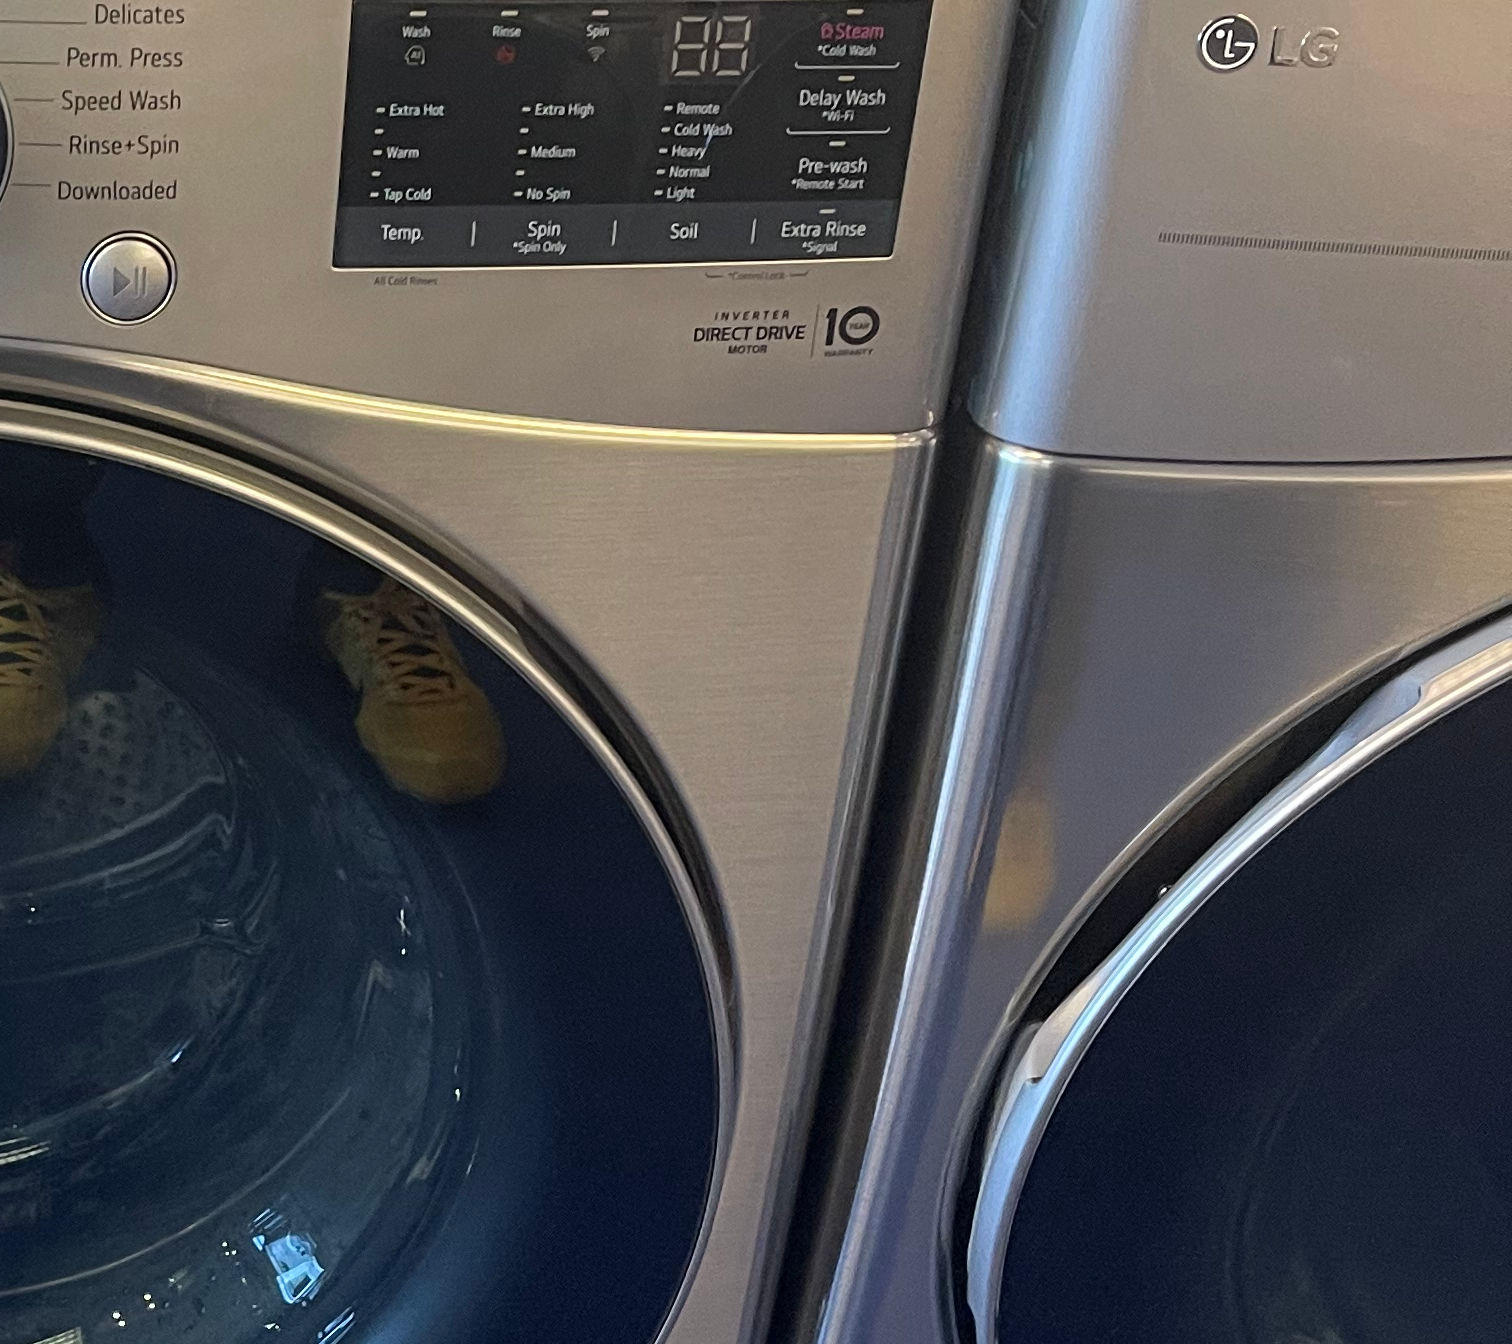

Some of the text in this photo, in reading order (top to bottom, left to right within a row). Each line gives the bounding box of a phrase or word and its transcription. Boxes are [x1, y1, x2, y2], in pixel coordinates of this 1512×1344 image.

[94, 3, 185, 25] Delicates
[402, 25, 431, 38] Wash
[492, 25, 522, 38] Rinse
[586, 24, 610, 40] Spin
[835, 22, 885, 40] Steam
[849, 44, 877, 57] Wash
[1268, 24, 1340, 68] LG
[66, 46, 184, 69] Perm. Press
[61, 88, 182, 116] Speed Wash
[798, 88, 886, 110] Delay Wash
[389, 103, 445, 117] Extra Hot
[534, 102, 595, 119] Extra High
[676, 102, 721, 115] Remote
[674, 122, 733, 136] Cold Wash
[68, 133, 180, 160] Rinse+Spin
[386, 145, 420, 159] Warm
[530, 144, 576, 158] Medium
[671, 144, 707, 160] Heavy
[668, 165, 711, 178] Normal
[798, 156, 868, 174] Pre-wash
[57, 179, 178, 201] Downloaded
[837, 177, 865, 190] Start
[383, 187, 432, 204] Tap Cold
[526, 186, 571, 203] No Spin
[666, 185, 696, 202] Light
[380, 223, 425, 245] Temp.
[527, 220, 561, 241] Spin
[669, 222, 700, 240] Soil
[780, 219, 867, 238] Extra Rinse
[542, 240, 567, 256] Only
[713, 309, 790, 321] INVERTER
[693, 324, 808, 343] DIRECT DRIVE
[824, 305, 881, 346] 10
[727, 344, 768, 355] MOTOR
